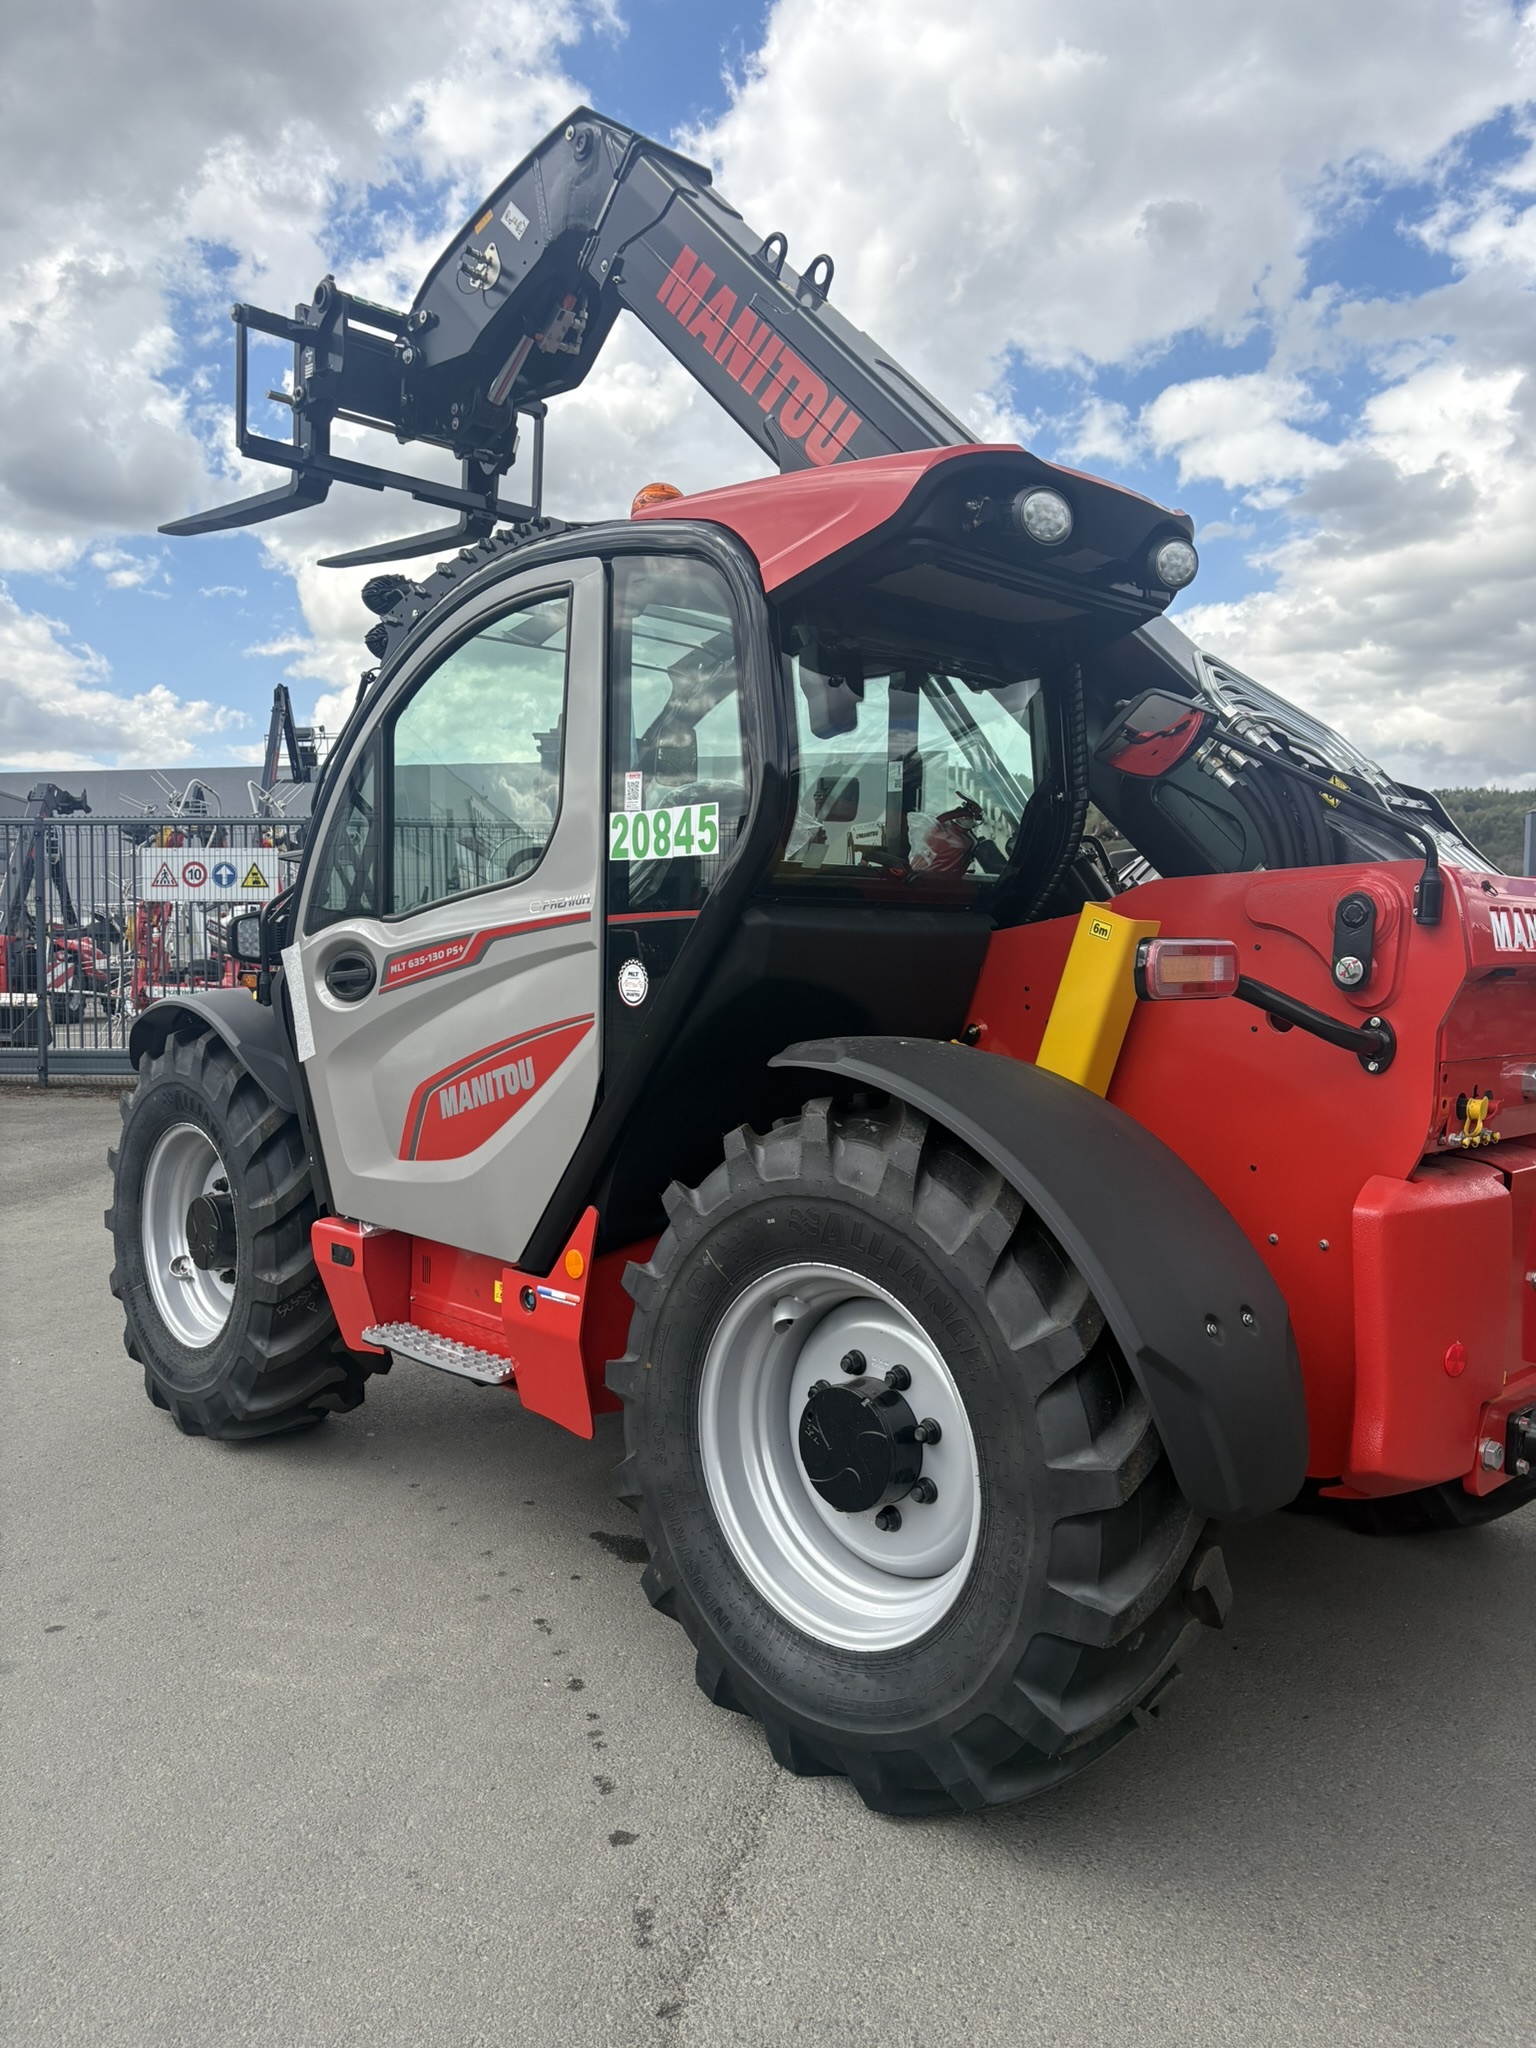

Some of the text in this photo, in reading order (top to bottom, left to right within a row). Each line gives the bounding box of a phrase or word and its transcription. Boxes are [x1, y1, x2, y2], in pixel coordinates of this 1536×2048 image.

[656, 244, 863, 467] MANITOU
[611, 804, 718, 859] 20845
[187, 868, 202, 880] 10
[542, 893, 591, 911] PREMIUM
[1093, 923, 1108, 937] 6m
[390, 944, 464, 974] MLT 635-130 PS+
[438, 1055, 536, 1120] MANITOU
[819, 1210, 992, 1377] ALLIANCE
